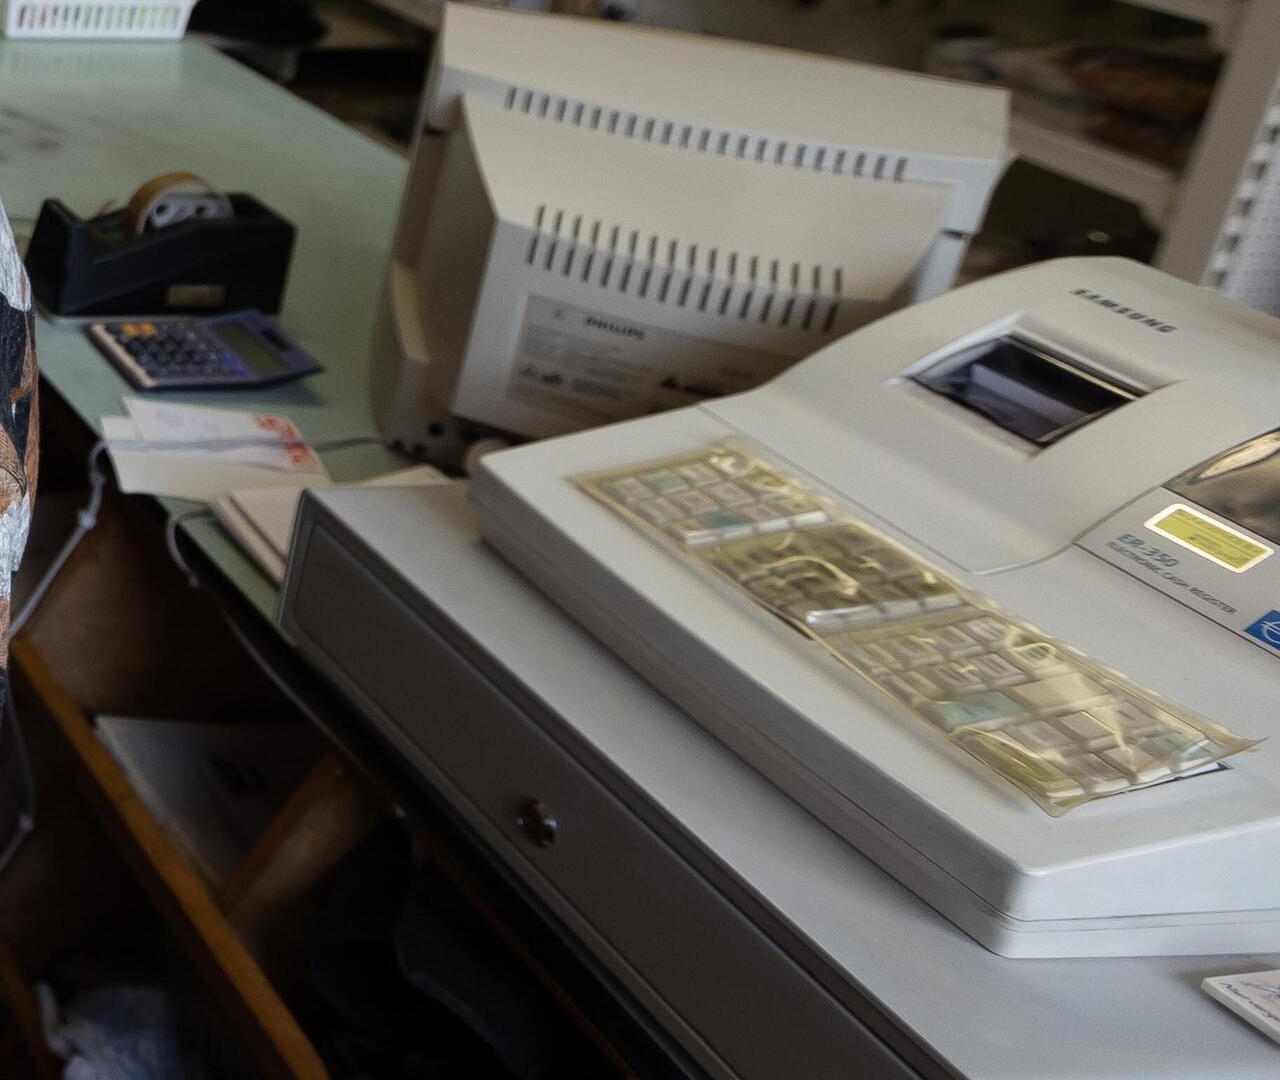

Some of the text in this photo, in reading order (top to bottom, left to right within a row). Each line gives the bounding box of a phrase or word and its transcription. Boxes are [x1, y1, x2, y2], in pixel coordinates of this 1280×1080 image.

[1069, 287, 1178, 333] SAMSUNG
[585, 316, 646, 339] PHILIPS
[1116, 533, 1180, 568] ER-350
[1189, 586, 1237, 614] REGISTER
